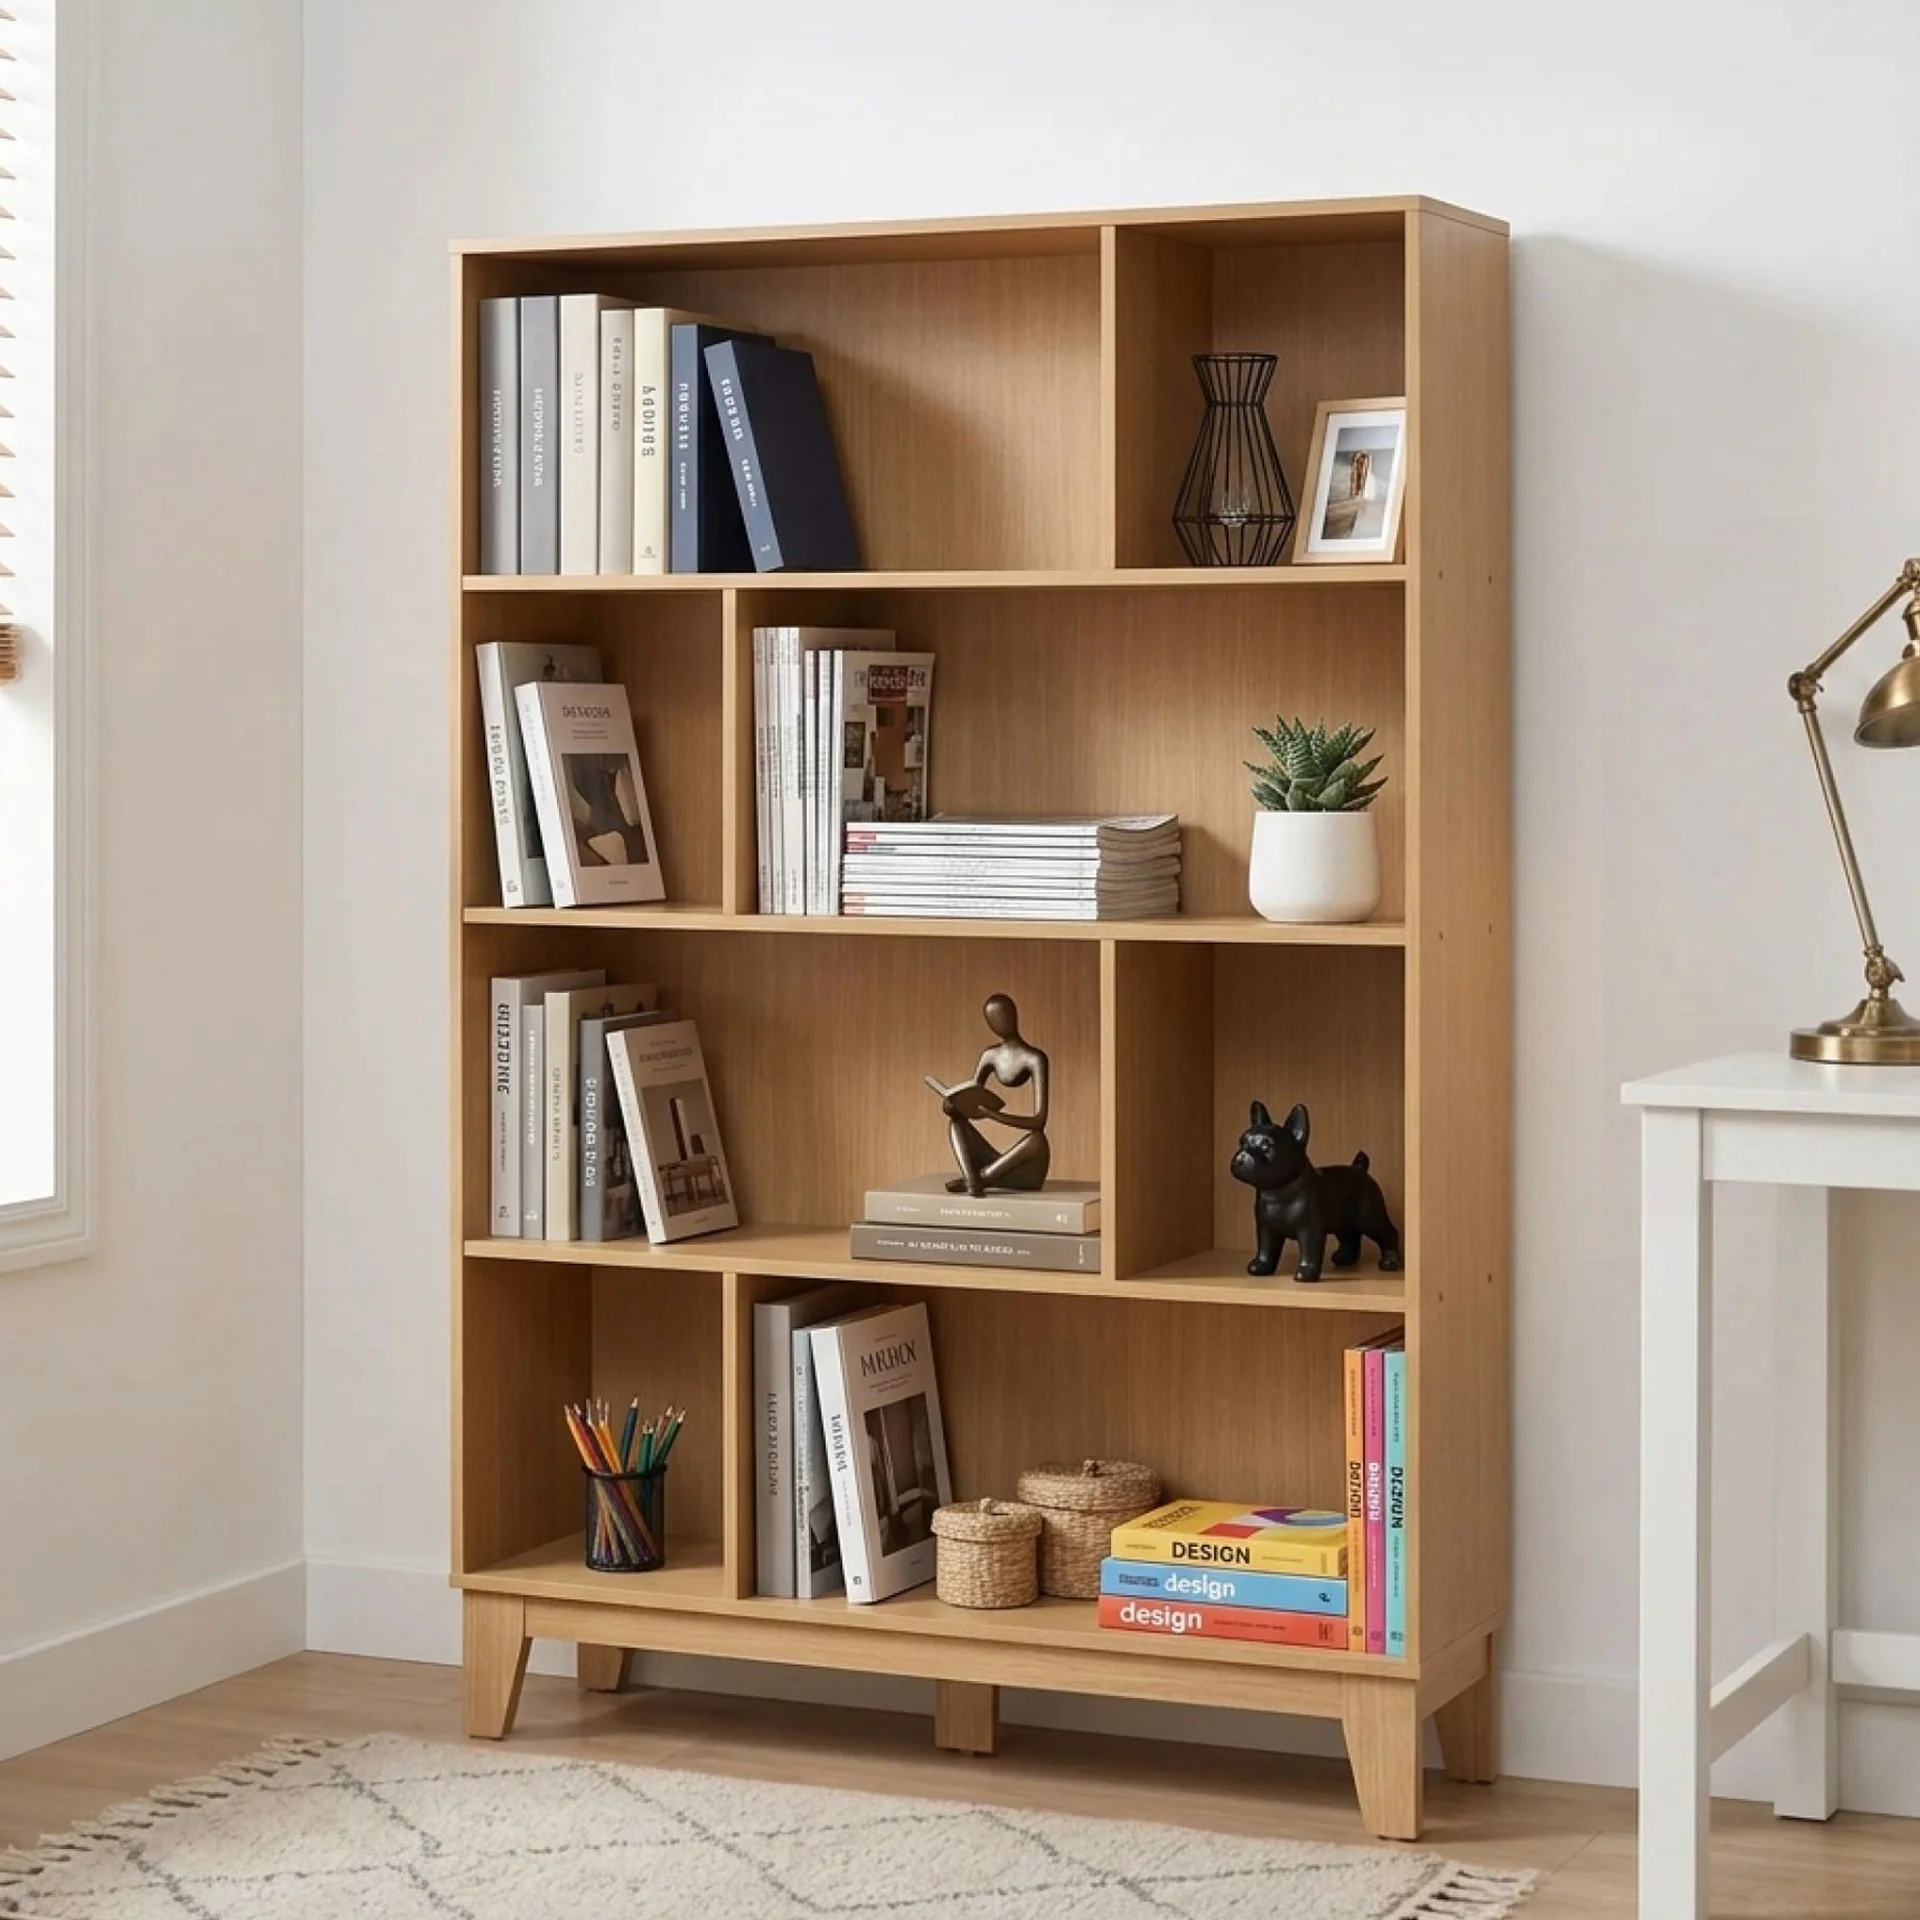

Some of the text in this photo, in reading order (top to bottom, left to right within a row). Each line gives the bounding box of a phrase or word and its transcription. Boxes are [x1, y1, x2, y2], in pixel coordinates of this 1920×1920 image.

[1172, 1541, 1251, 1565] DESIGN
[1164, 1573, 1236, 1600] design
[1120, 1602, 1203, 1633] design
